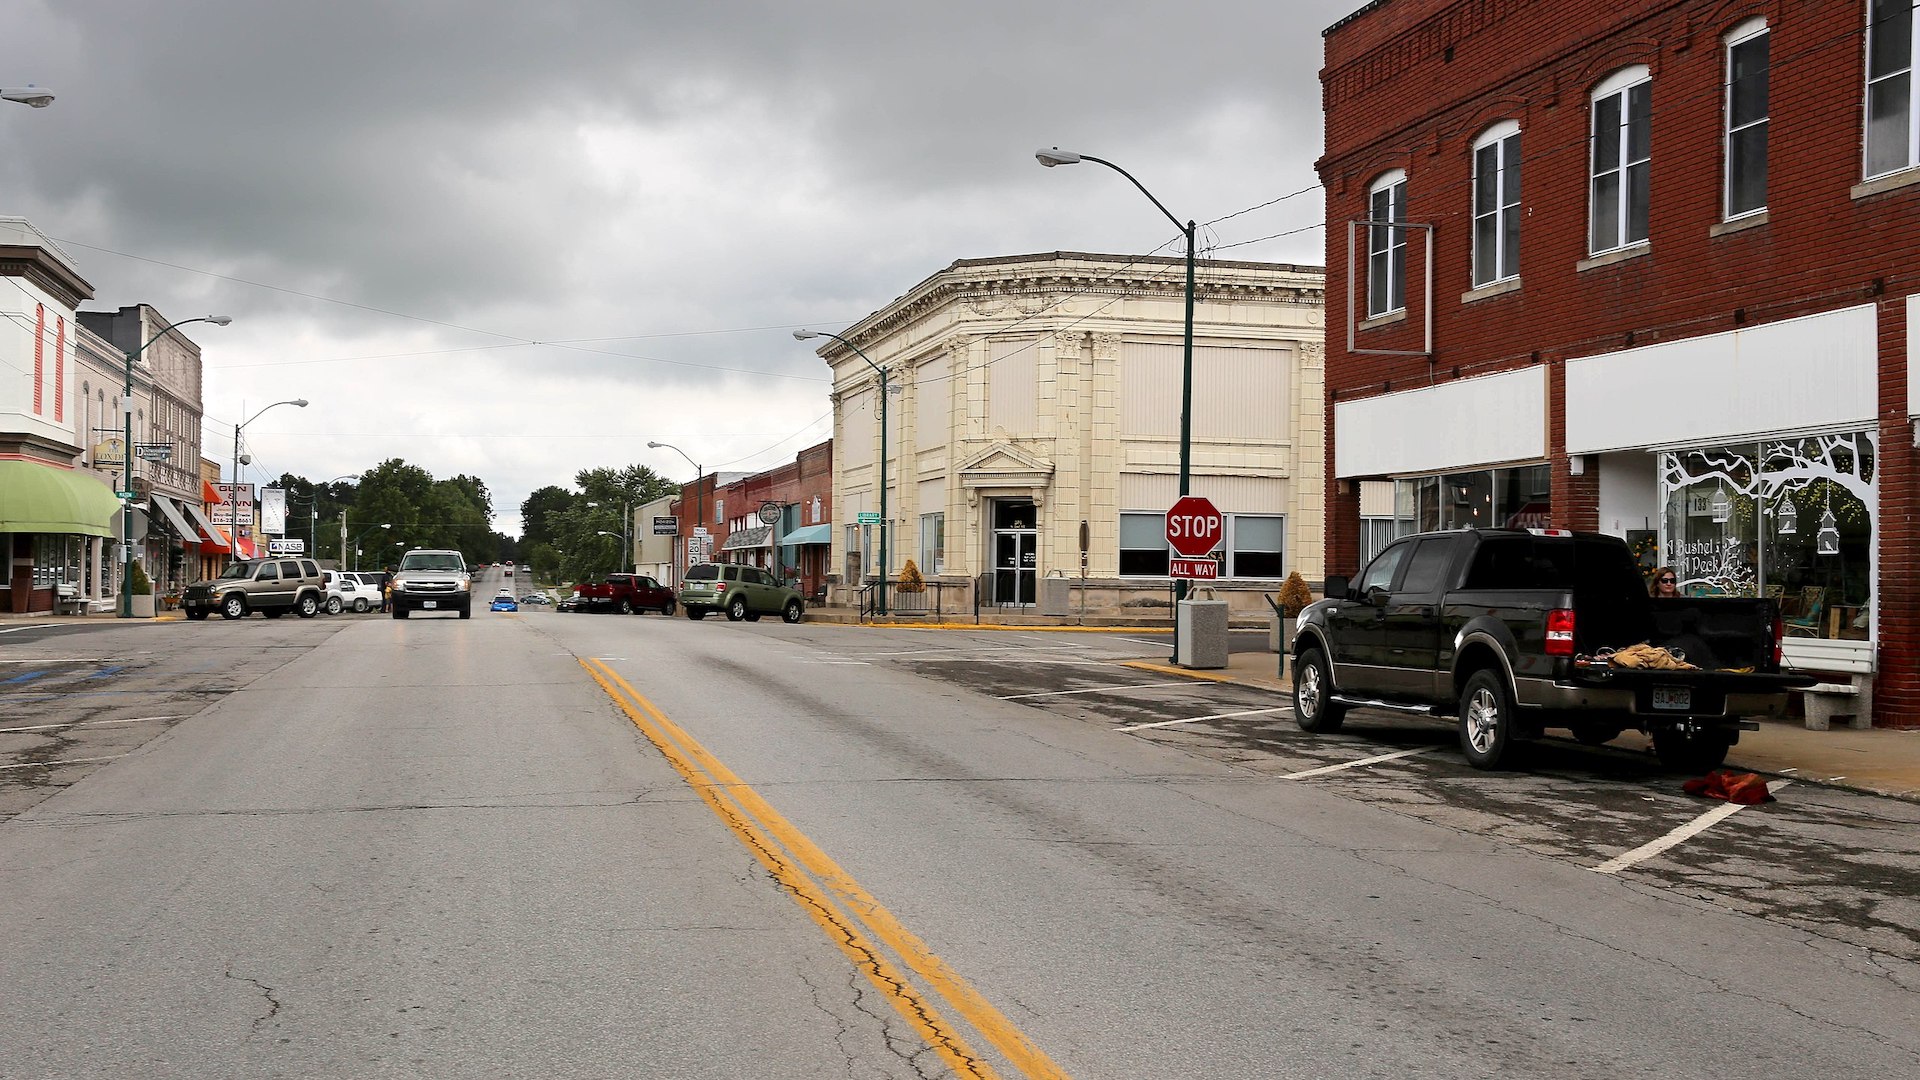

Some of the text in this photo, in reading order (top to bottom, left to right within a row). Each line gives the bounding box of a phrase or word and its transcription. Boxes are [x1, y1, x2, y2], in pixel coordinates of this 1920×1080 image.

[1694, 497, 1707, 511] 133
[1169, 515, 1219, 537] STOP
[689, 545, 700, 553] 20
[1675, 538, 1713, 556] Bushel
[1171, 563, 1216, 576] ALL WAY
[1691, 555, 1720, 576] Peck
